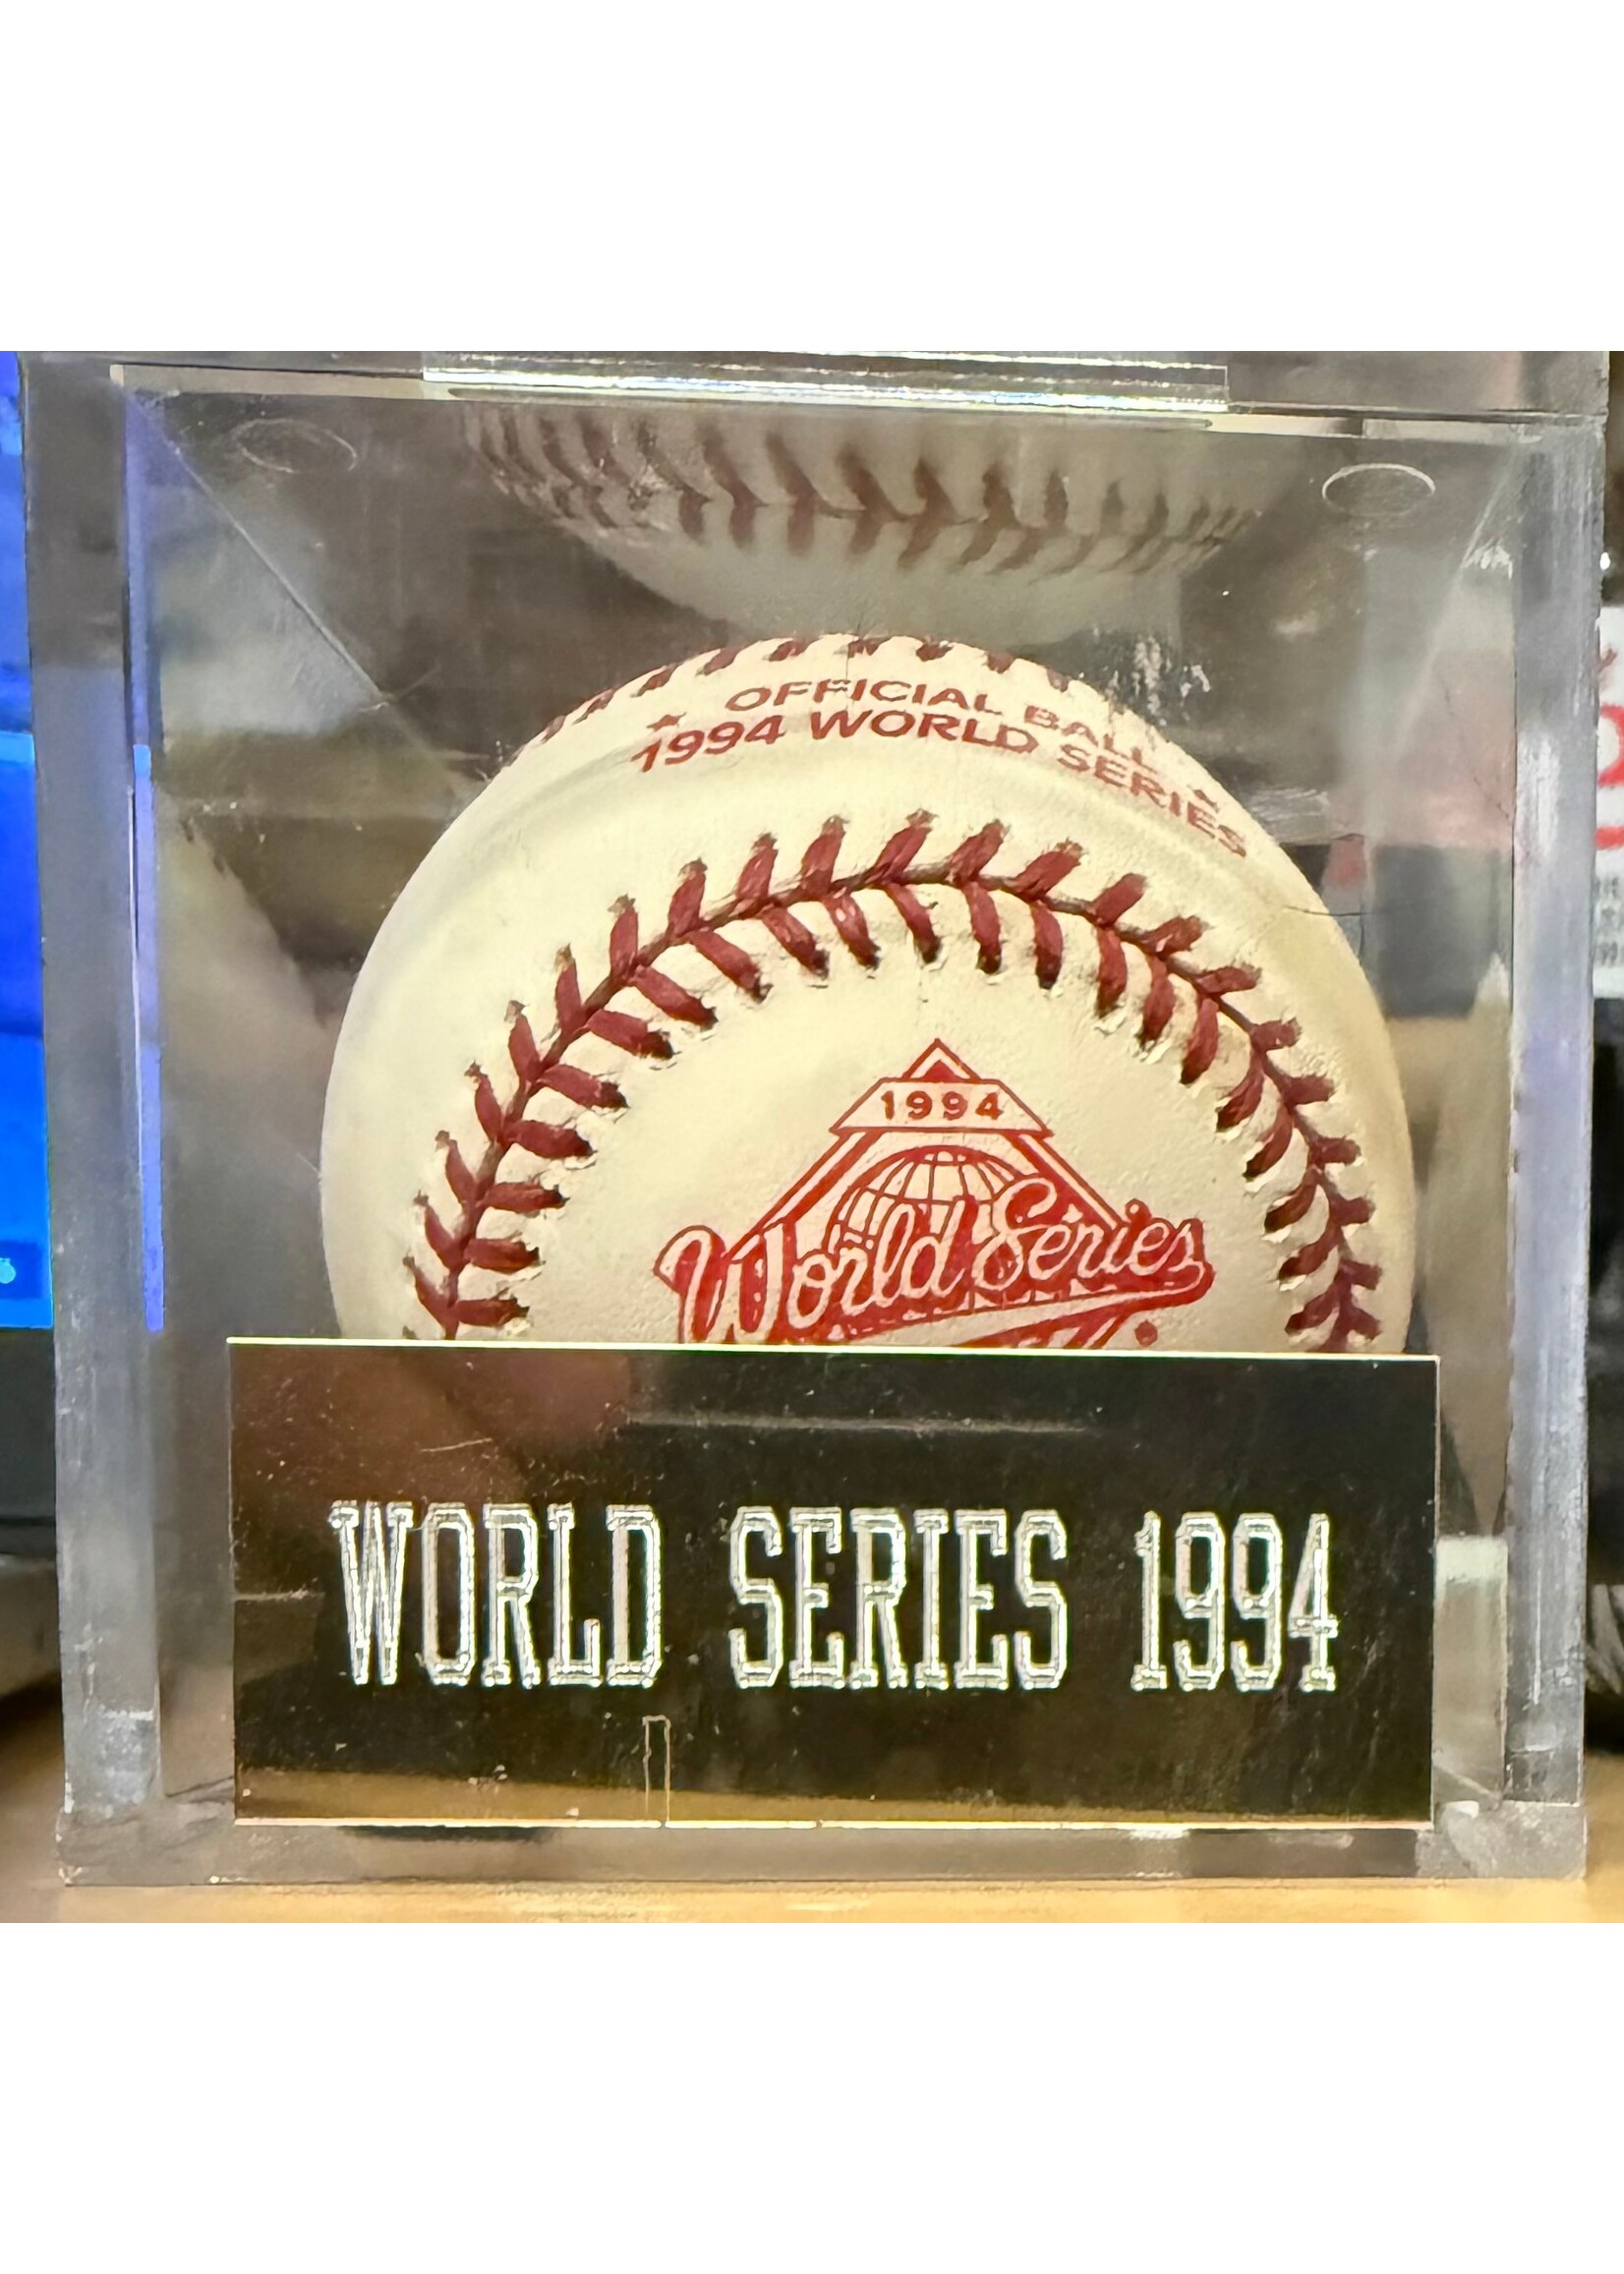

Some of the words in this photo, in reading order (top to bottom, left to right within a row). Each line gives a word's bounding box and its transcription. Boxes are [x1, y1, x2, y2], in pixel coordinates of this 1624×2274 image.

[631, 714, 786, 773] 1994
[810, 709, 1039, 754] WORLD
[1057, 743, 1247, 857] SERIES
[725, 678, 1003, 715] OFFICIAL
[1023, 705, 1159, 776] BALL
[880, 1089, 1005, 1121] 1994
[661, 1197, 969, 1343] World
[973, 1178, 1205, 1292] Series
[328, 1499, 664, 1689] WORLD
[726, 1504, 1069, 1689] SERIES
[1130, 1510, 1339, 1692] 1994
